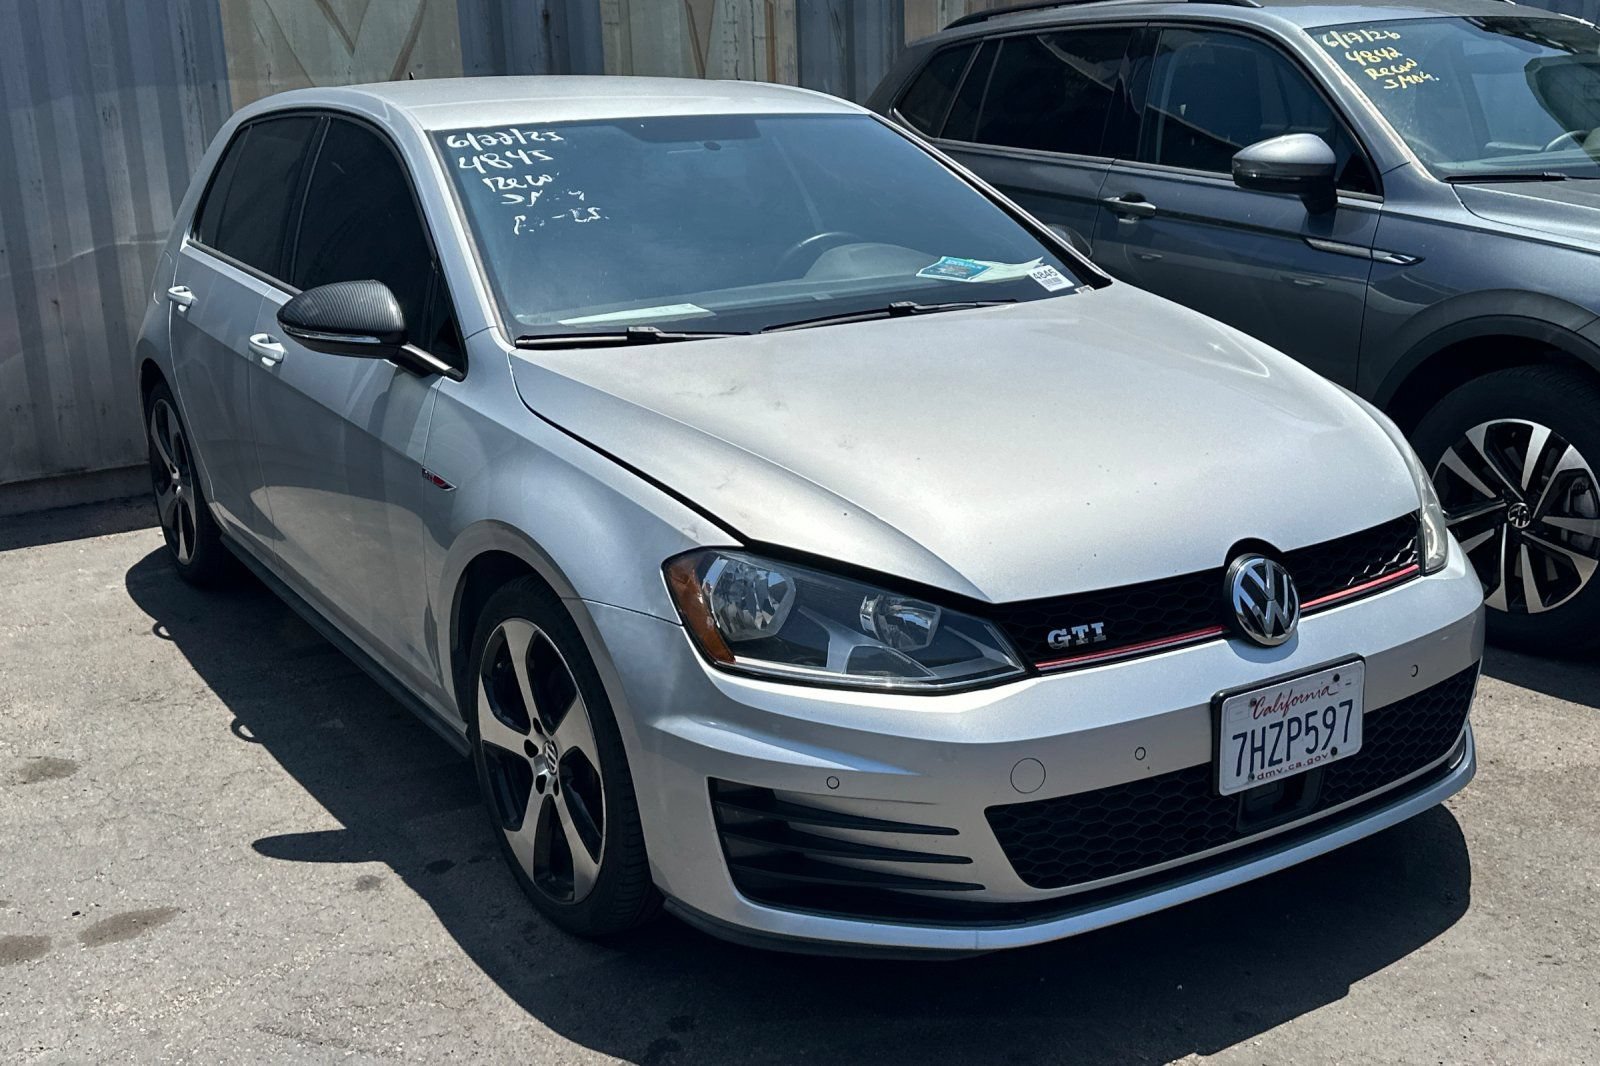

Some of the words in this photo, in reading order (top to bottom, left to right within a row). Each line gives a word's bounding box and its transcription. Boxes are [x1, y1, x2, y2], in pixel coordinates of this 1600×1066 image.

[1345, 46, 1403, 66] 4842
[458, 149, 554, 174] 4845
[1033, 269, 1058, 279] 4845
[1047, 621, 1107, 650] GTI
[1253, 683, 1339, 720] California
[1232, 698, 1354, 777] 7HZP597
[1257, 753, 1328, 781] dmv.ca.gov
